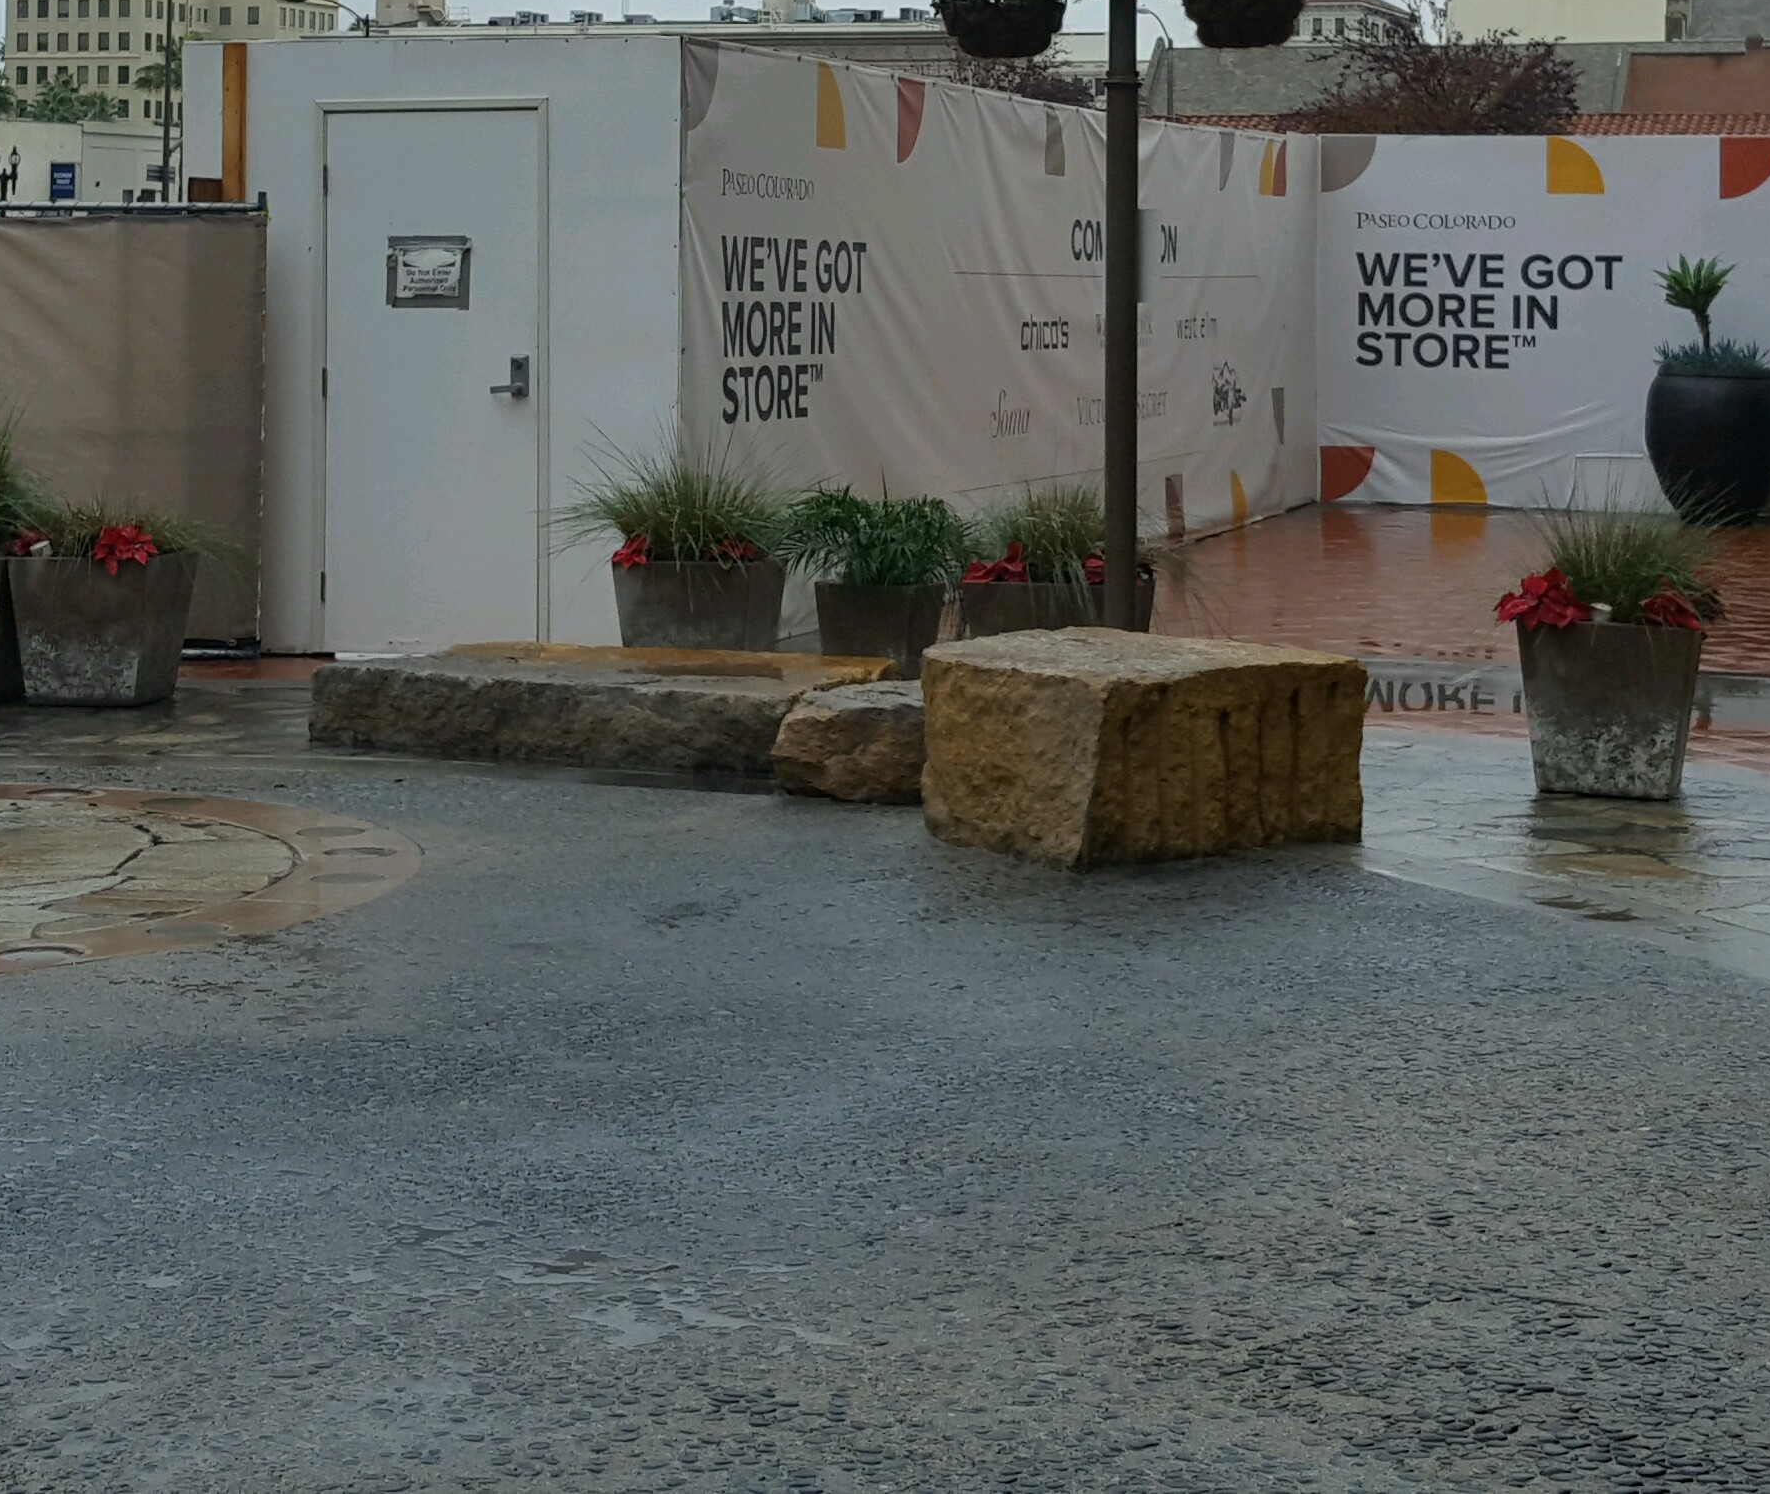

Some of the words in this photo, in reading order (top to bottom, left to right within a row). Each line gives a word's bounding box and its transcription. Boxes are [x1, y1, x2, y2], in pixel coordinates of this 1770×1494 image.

[721, 168, 755, 196] PASEO
[756, 173, 815, 201] COLORADO
[1356, 211, 1410, 229] PASEO
[1413, 212, 1517, 231] COLORADO
[721, 235, 808, 293] WE'VE
[815, 239, 867, 294] GOT
[1356, 251, 1505, 289] WE'VE
[1520, 254, 1624, 290] GOT
[722, 301, 803, 358] MORE
[809, 302, 835, 355] IN
[1357, 291, 1496, 329] MORE
[1512, 294, 1559, 331] IN
[1020, 313, 1069, 351] chico's
